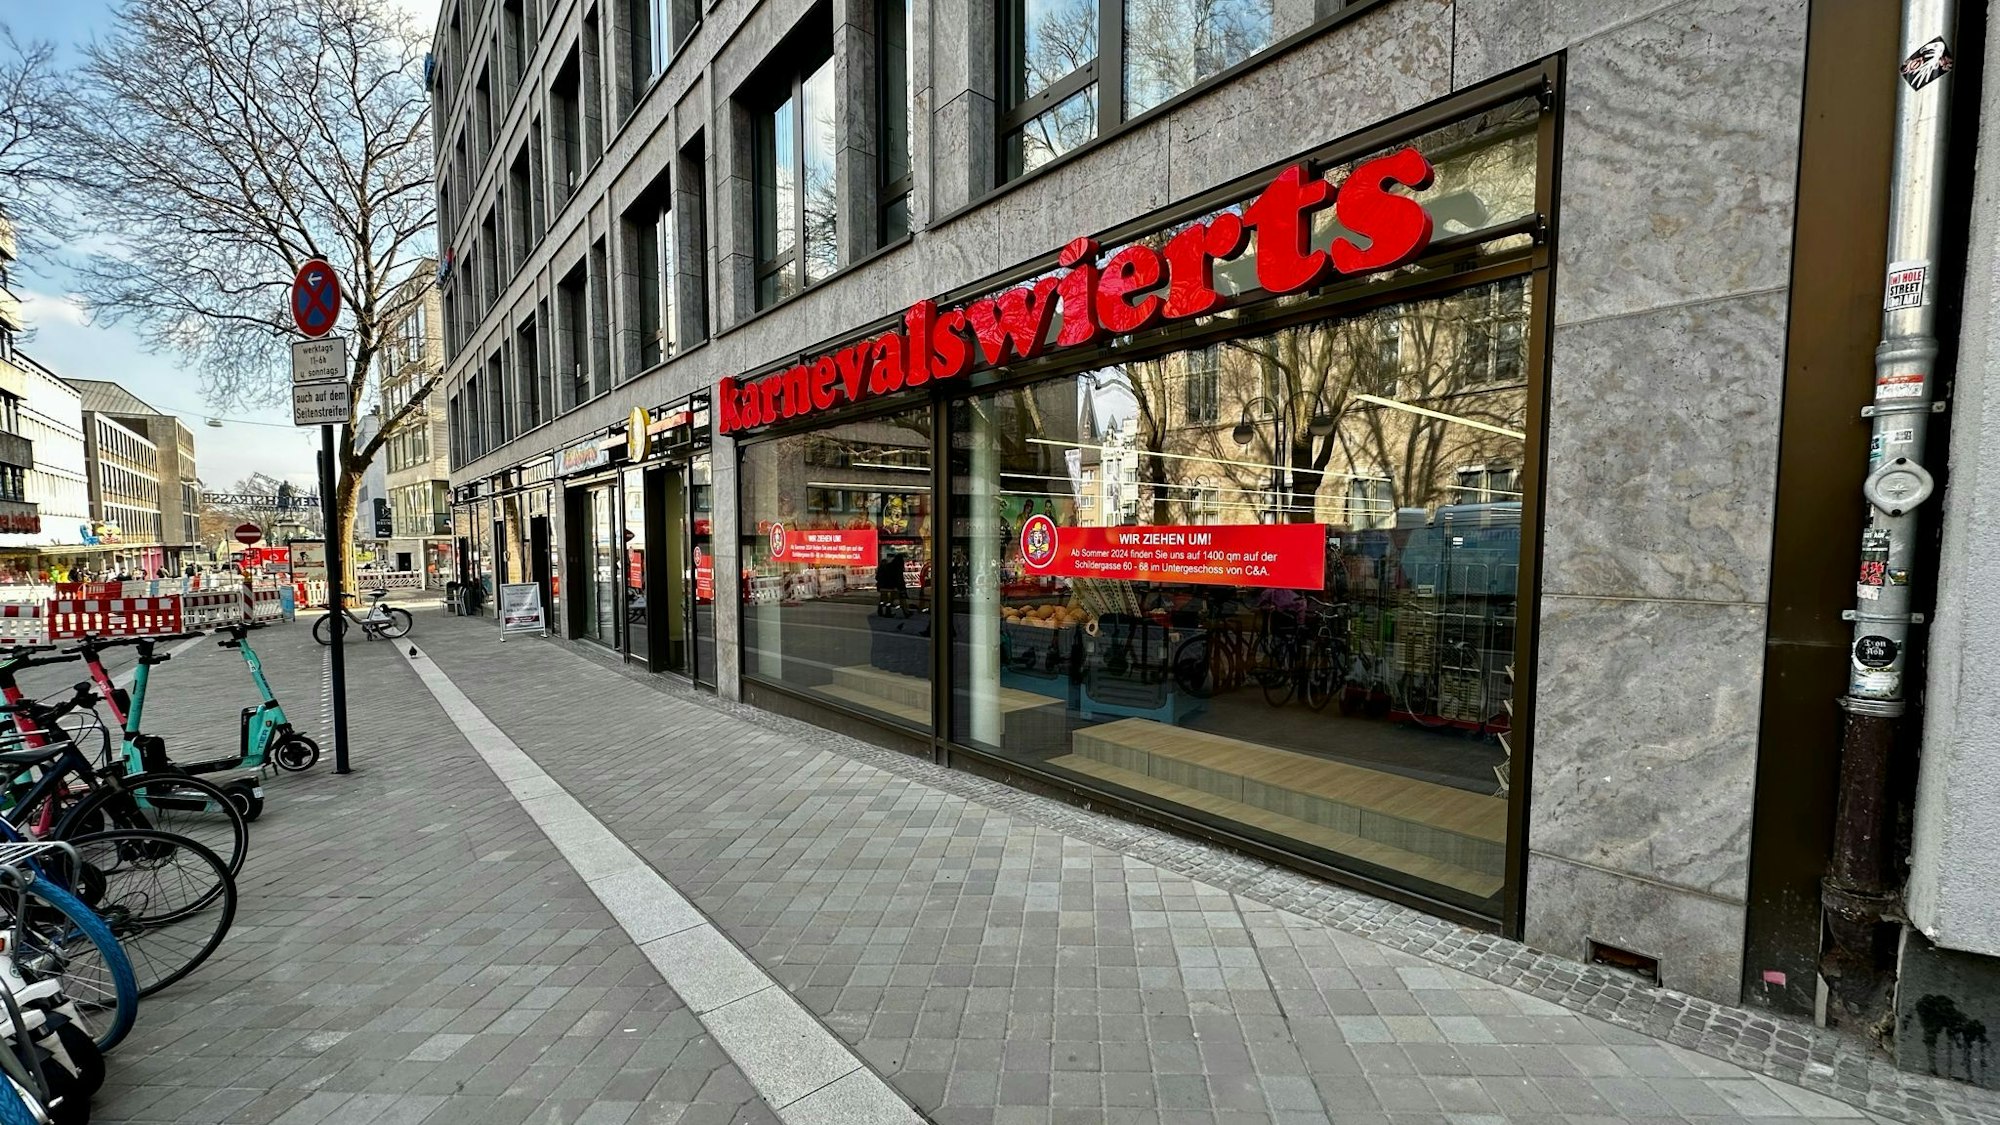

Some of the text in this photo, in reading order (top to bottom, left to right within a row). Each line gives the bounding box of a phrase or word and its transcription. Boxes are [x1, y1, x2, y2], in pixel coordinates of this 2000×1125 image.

[719, 146, 1435, 434] karnevalswierts
[1890, 282, 1920, 296] STREET
[302, 344, 334, 354] werktags
[308, 367, 339, 377] sonntags
[296, 389, 346, 403] auch auf dem
[296, 405, 348, 419] Seitenstreifen
[1119, 532, 1212, 545] WIR ZIEHEN UM!
[1071, 548, 1278, 563] Ab Sommer 2024 finden Sie uns auf 1400 qm auf der
[1074, 560, 1122, 572] Schildergasse
[1122, 561, 1133, 571] 60
[1139, 562, 1149, 571] 68
[1150, 563, 1160, 571] im
[1162, 562, 1224, 575] Untergeschoss
[1226, 566, 1243, 575] von
[1245, 565, 1270, 576] C&A.
